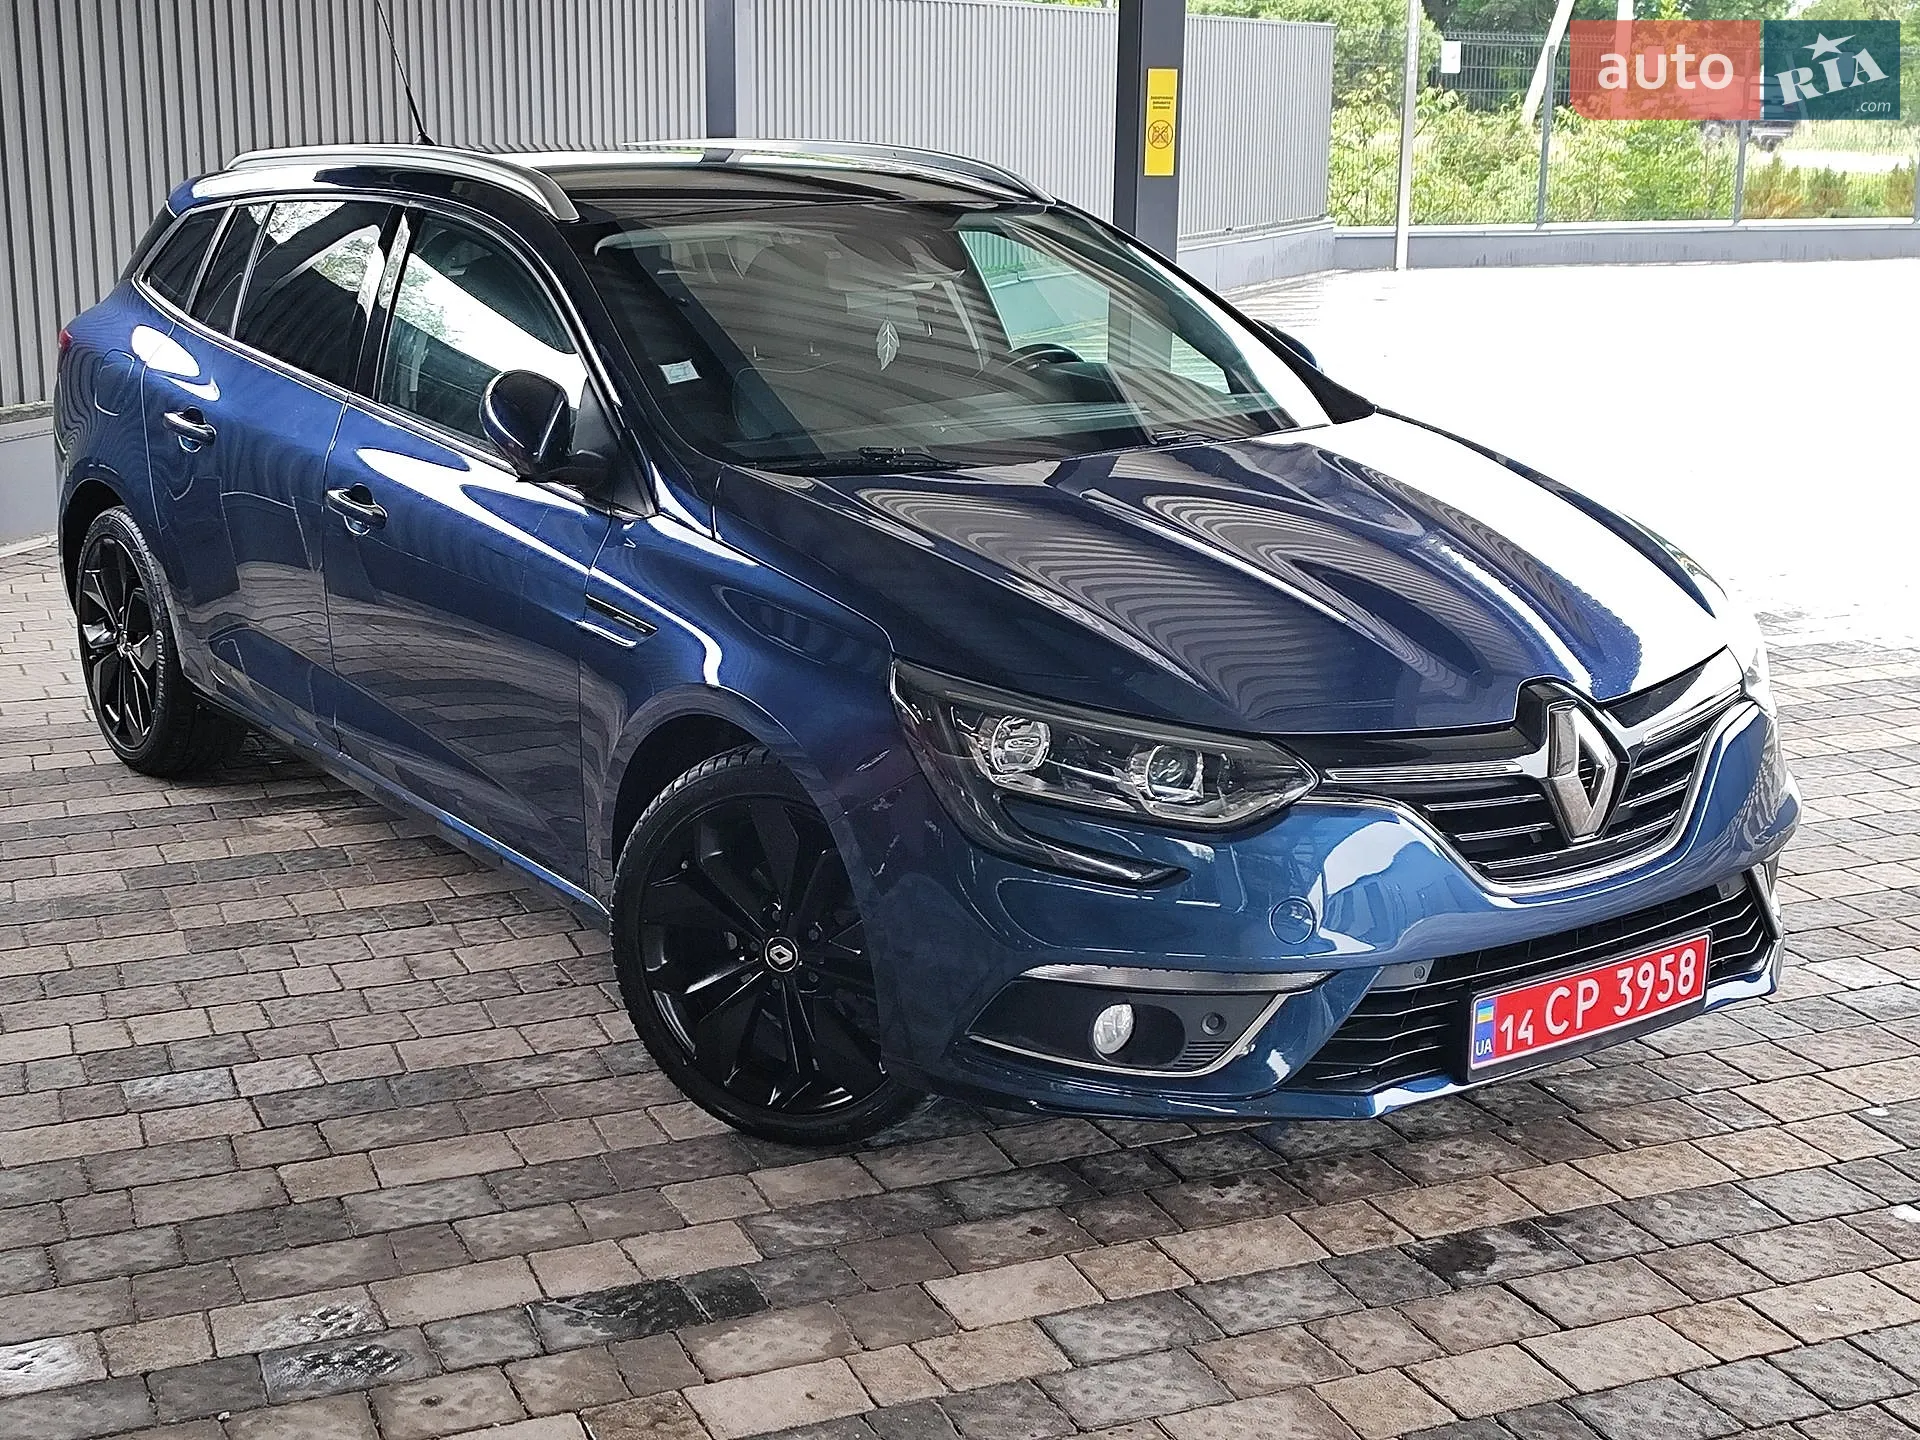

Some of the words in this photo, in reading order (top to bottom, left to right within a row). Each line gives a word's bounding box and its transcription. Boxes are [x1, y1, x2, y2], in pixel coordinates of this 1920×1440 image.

[1499, 1008, 1534, 1051] 14
[1545, 978, 1600, 1035] CP
[1613, 948, 1697, 1017] 3958
[1475, 1039, 1492, 1057] UA
